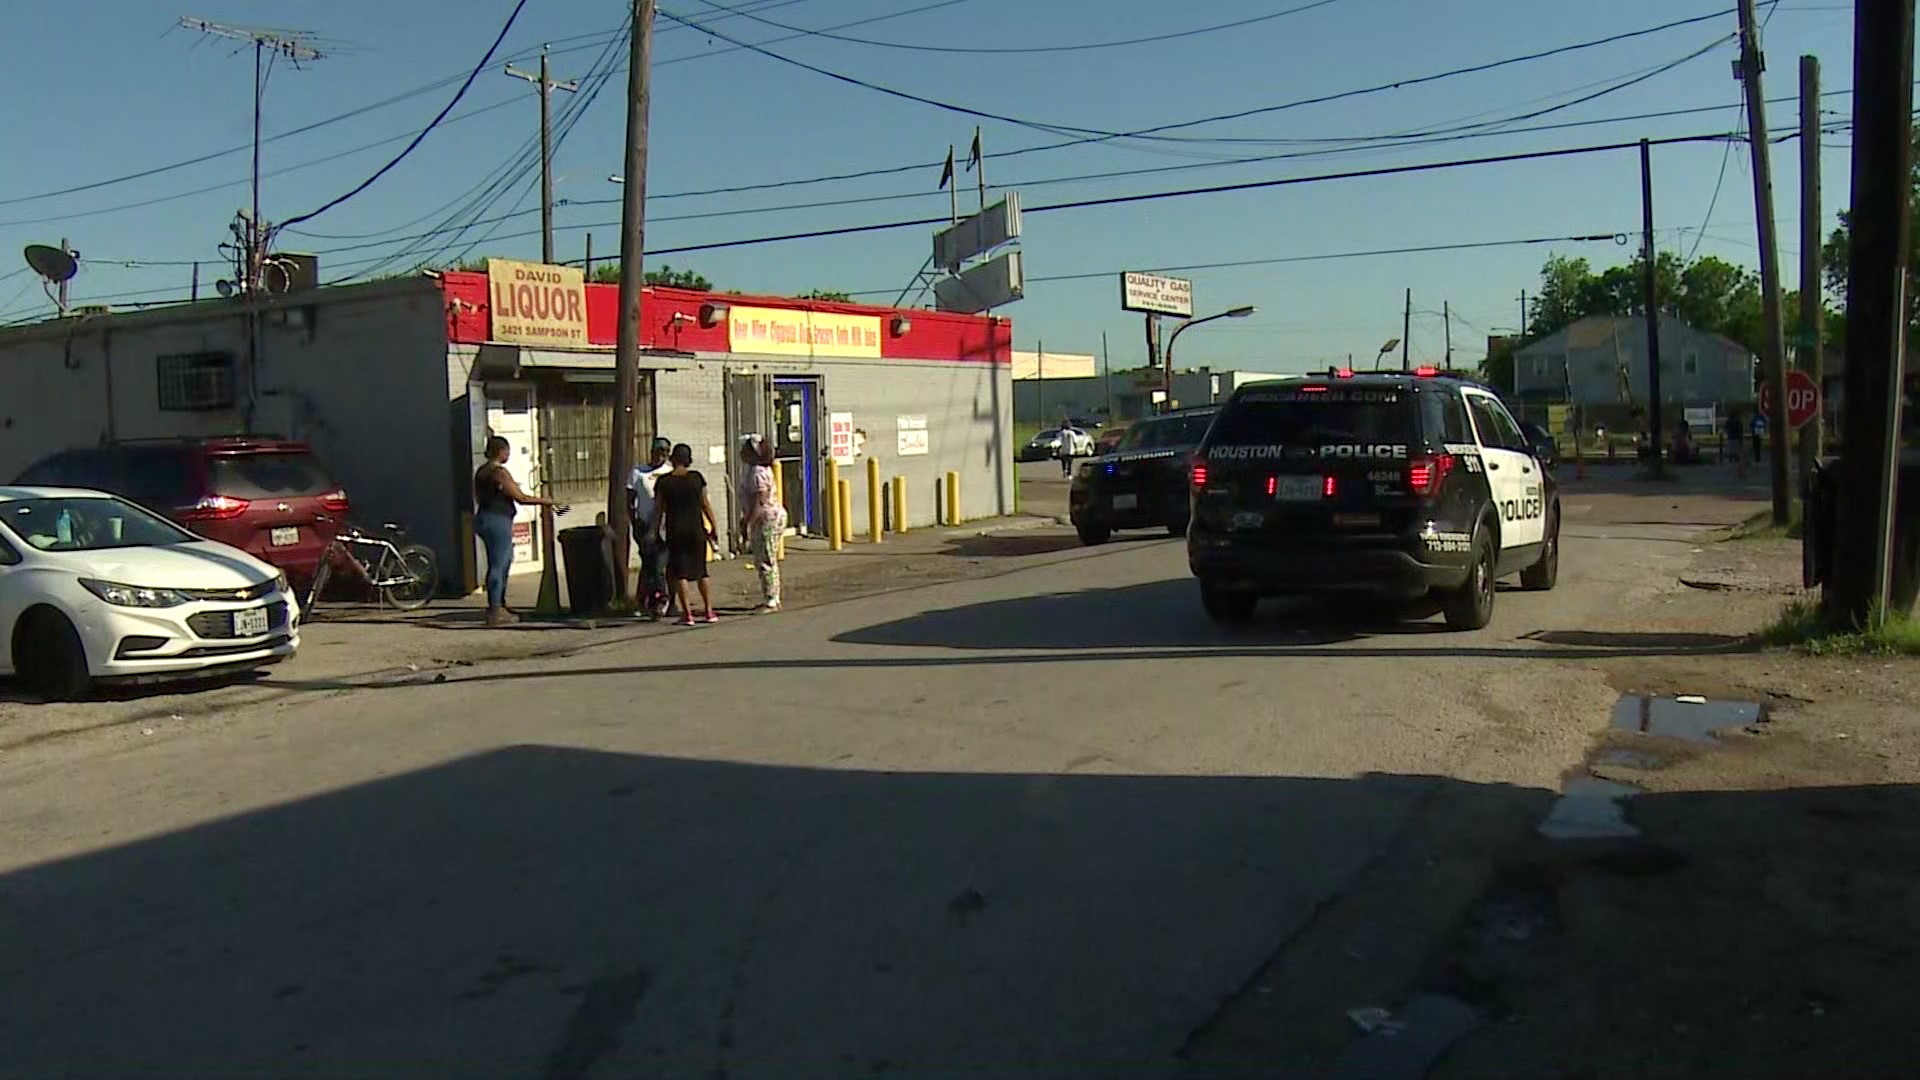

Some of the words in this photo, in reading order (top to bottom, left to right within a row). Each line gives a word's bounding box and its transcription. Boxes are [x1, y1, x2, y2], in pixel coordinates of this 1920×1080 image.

[515, 269, 561, 284] DAVID
[1127, 275, 1166, 289] QUALITY
[1170, 281, 1190, 292] GAS
[495, 282, 582, 322] LIQUOR
[1129, 288, 1158, 300] SERVICE
[1161, 293, 1189, 304] CENTER
[502, 325, 522, 335] 3421
[526, 326, 569, 337] SAMPSON
[571, 330, 581, 338] ST
[1208, 445, 1282, 459] HOUSTON
[1320, 444, 1408, 459] POLICE
[1463, 455, 1482, 472] 911
[1500, 498, 1539, 523] POLICE
